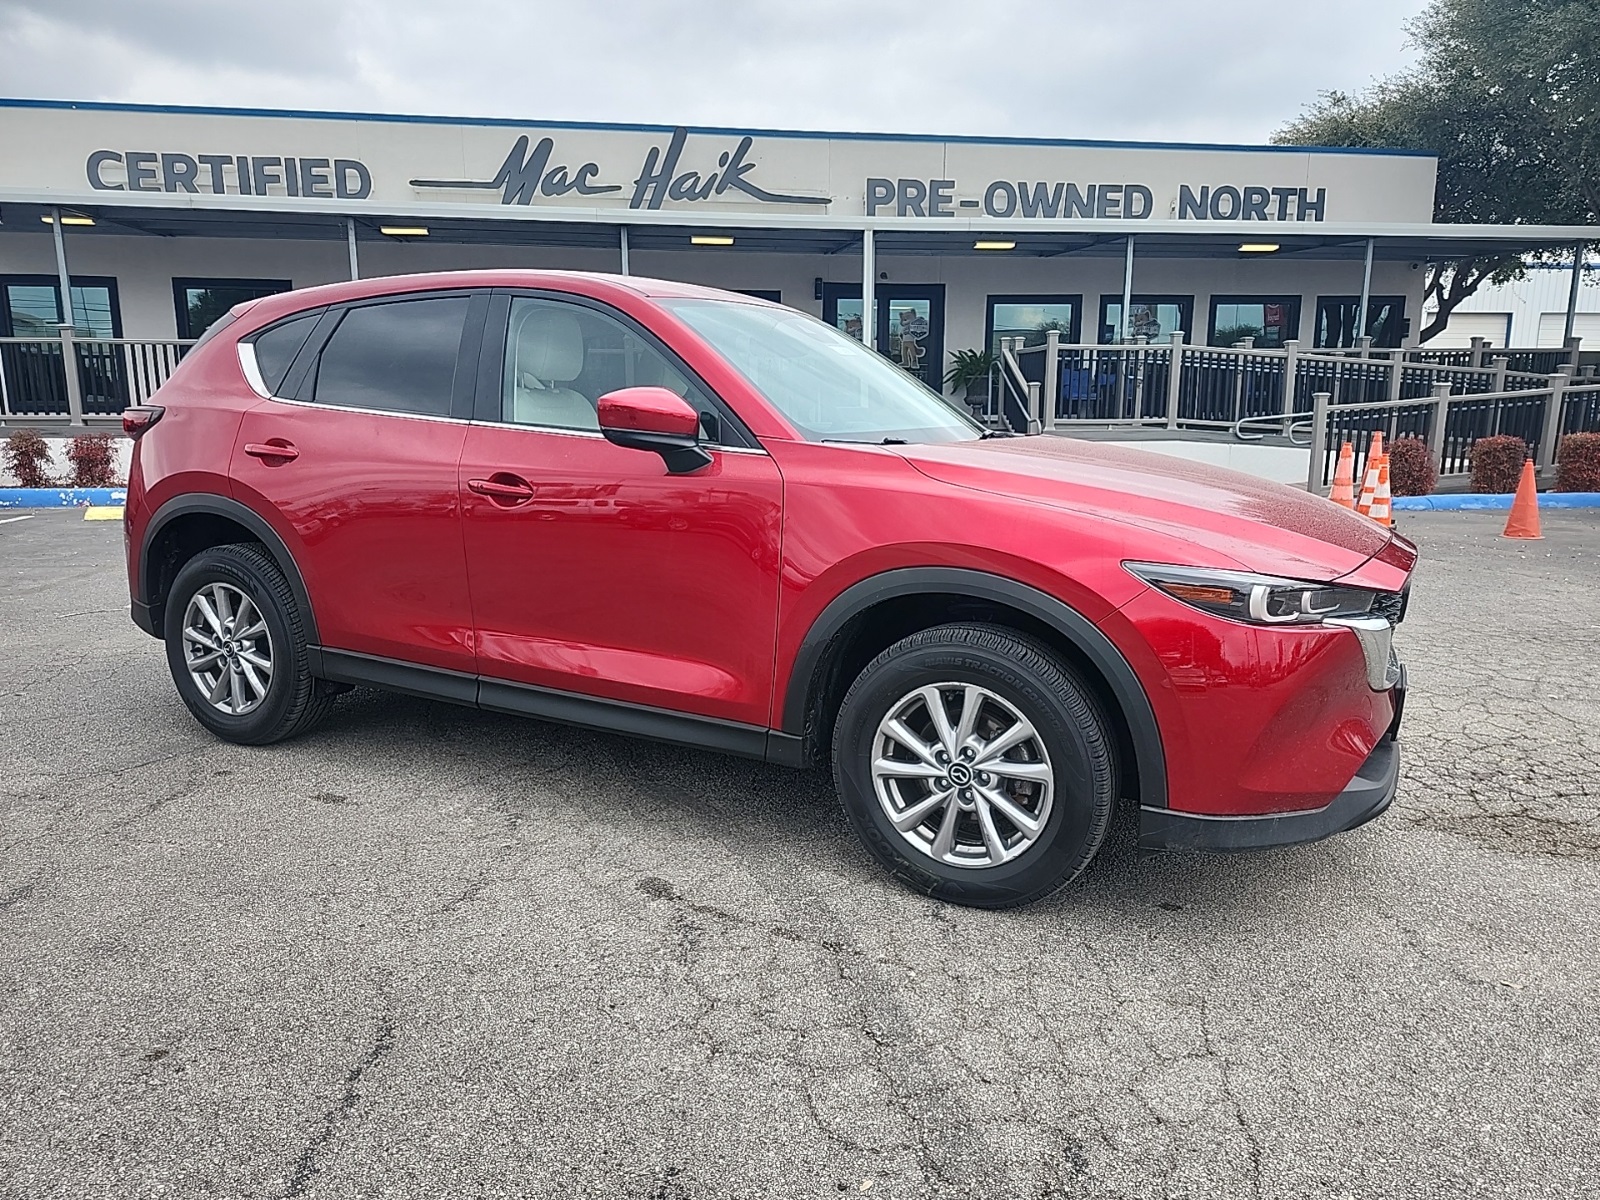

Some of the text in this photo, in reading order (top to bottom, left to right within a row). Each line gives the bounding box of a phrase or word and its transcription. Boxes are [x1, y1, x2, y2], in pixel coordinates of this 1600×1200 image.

[86, 150, 372, 199] CERTIFIED
[409, 127, 833, 210] Mac Haik
[866, 178, 1327, 222] PRE-OWNED NORTH
[963, 658, 1024, 690] TRACTION
